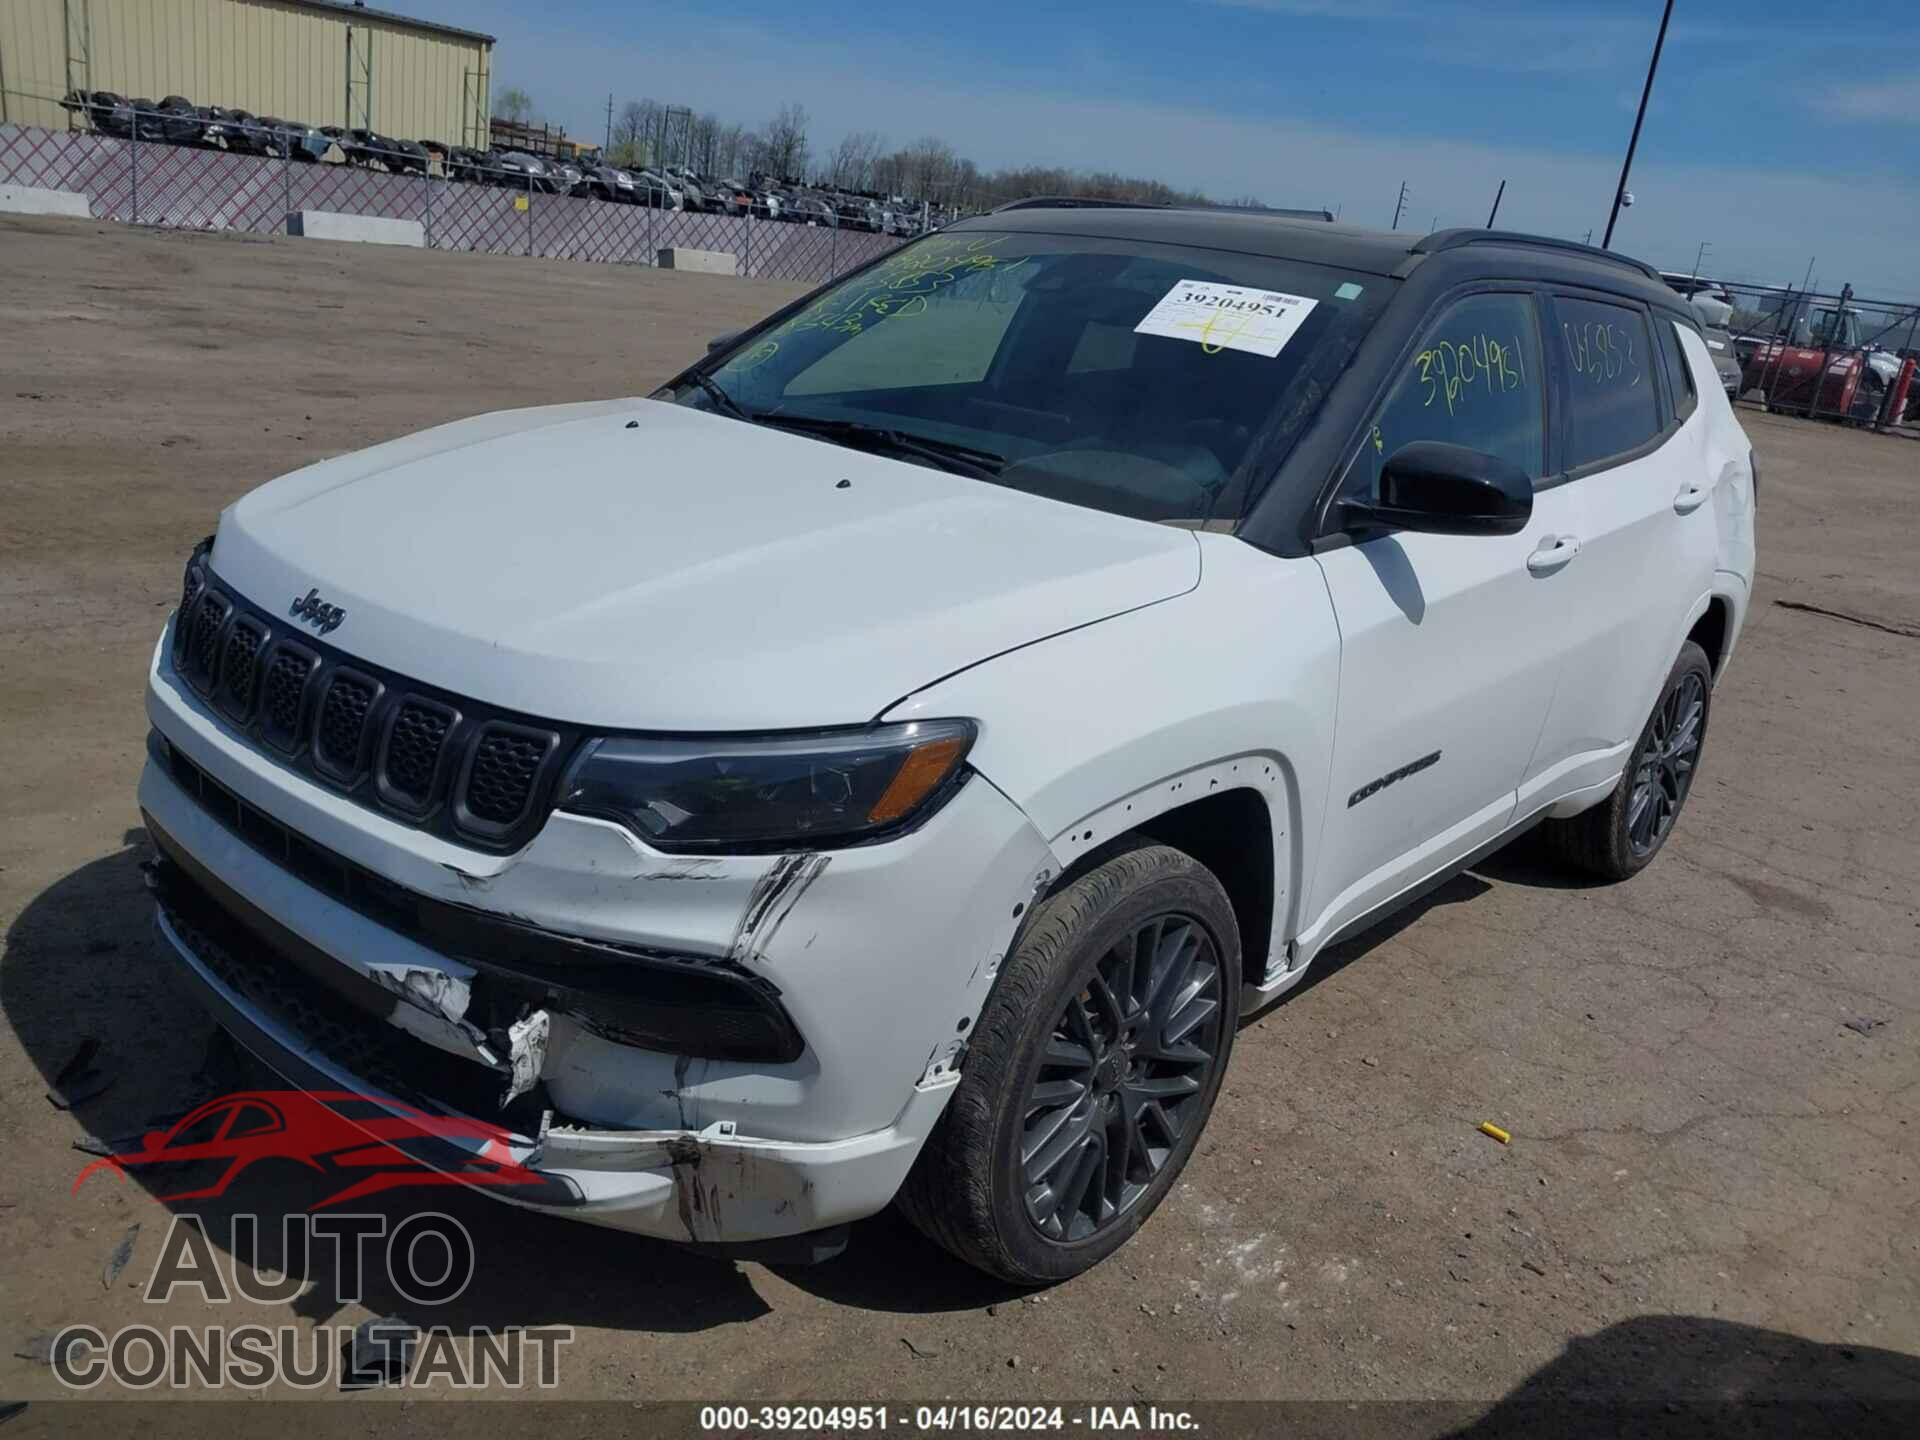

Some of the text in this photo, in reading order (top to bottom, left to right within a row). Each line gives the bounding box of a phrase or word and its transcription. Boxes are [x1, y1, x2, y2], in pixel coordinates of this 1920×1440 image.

[1177, 292, 1286, 318] 39204951
[1414, 333, 1526, 416] 39204951
[288, 588, 346, 636] Jeep
